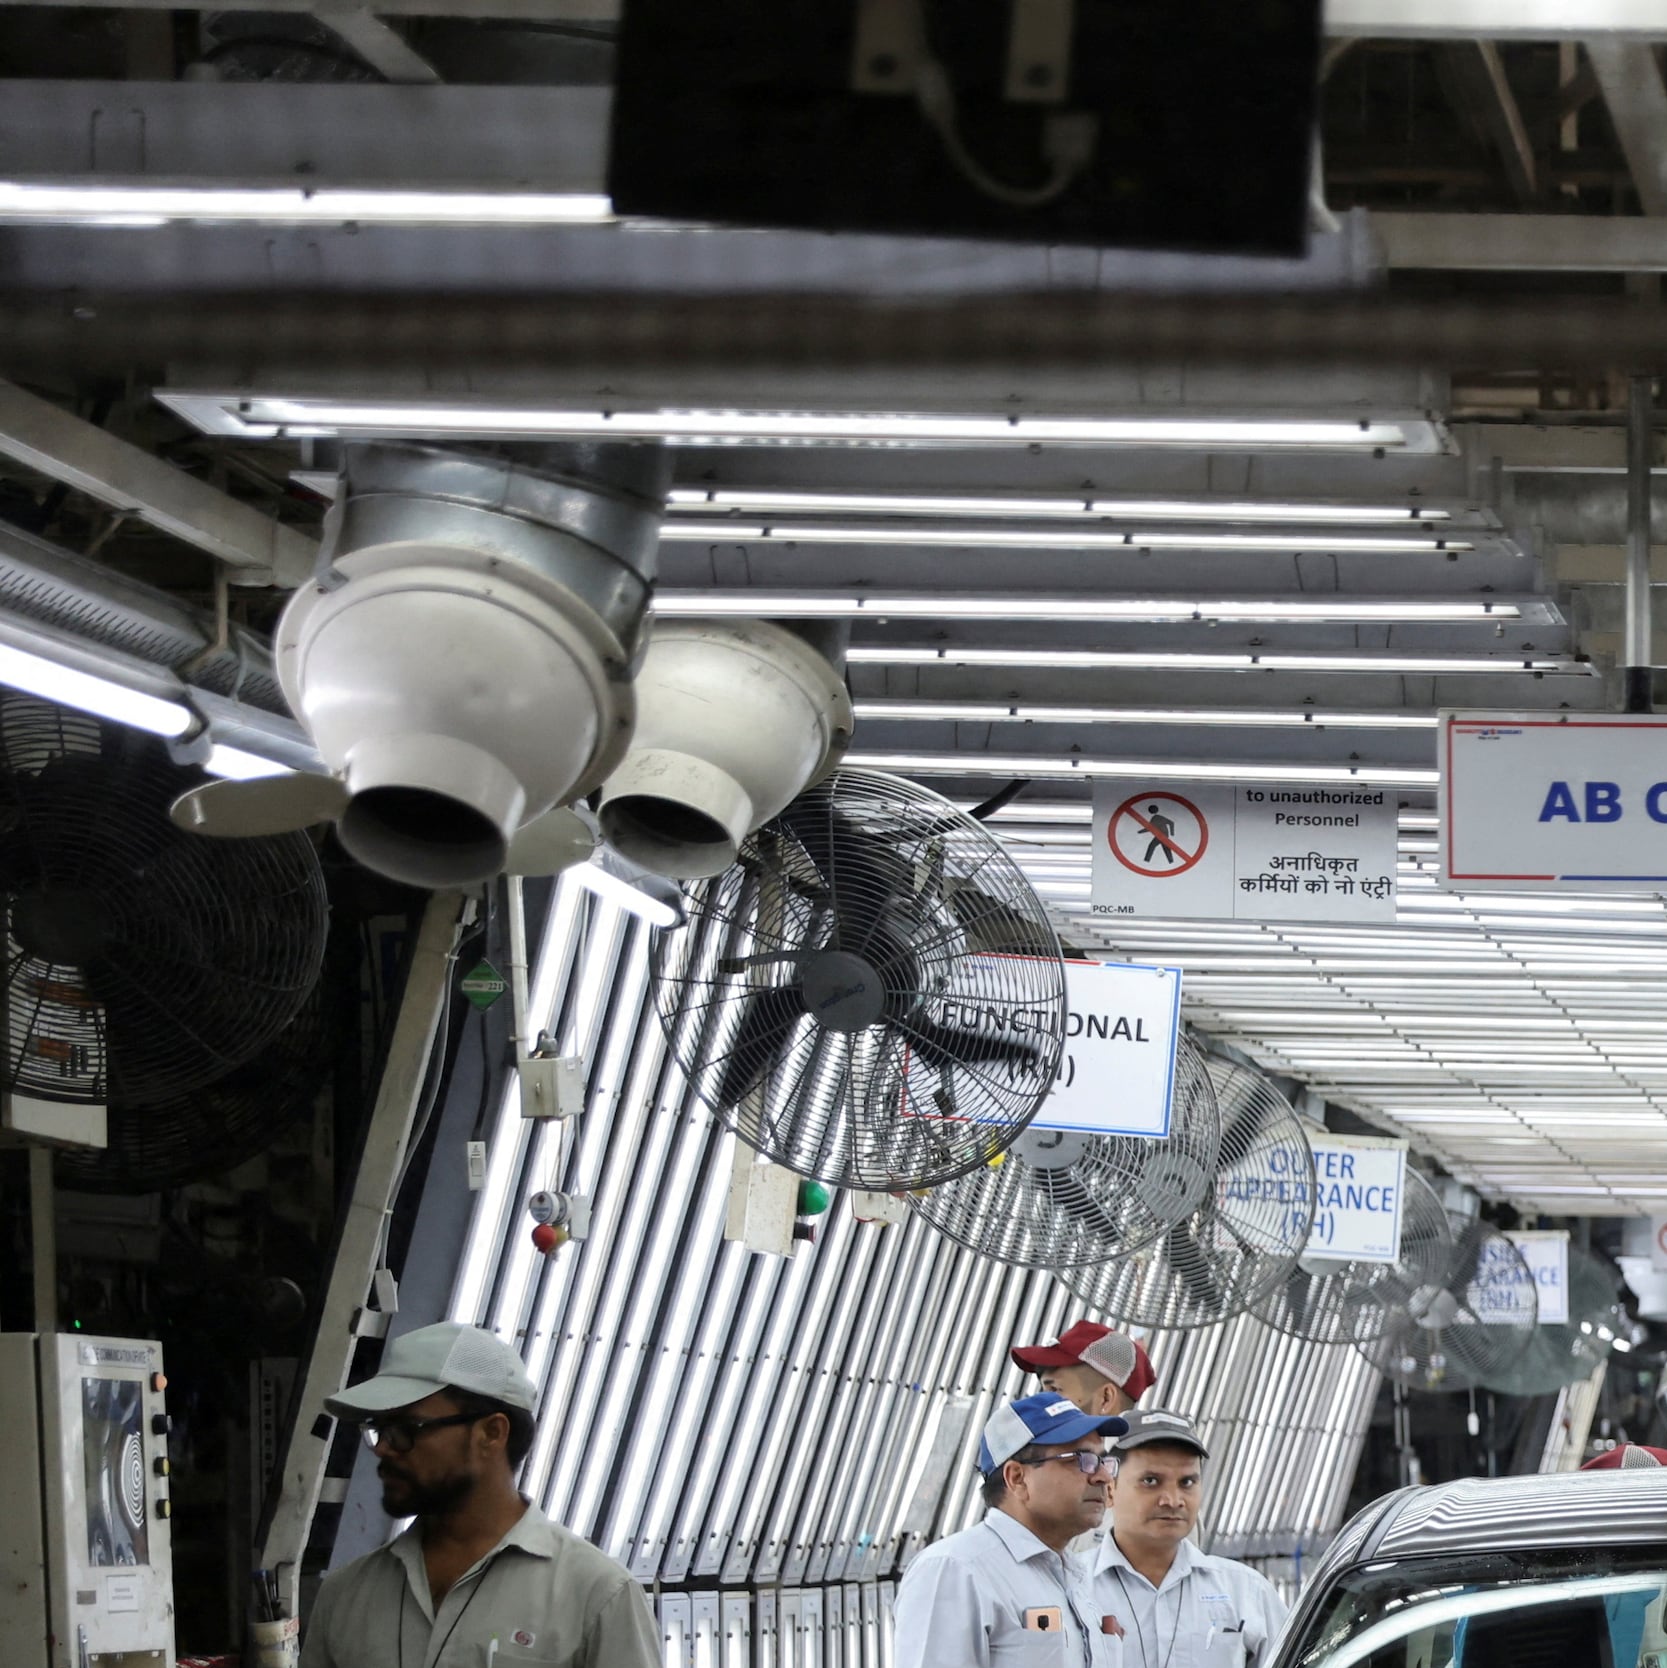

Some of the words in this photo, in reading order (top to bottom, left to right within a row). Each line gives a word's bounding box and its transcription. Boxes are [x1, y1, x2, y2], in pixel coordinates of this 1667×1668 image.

[1246, 789, 1265, 803] to
[1270, 790, 1384, 805] unauthorized
[1538, 781, 1623, 823] AB
[1275, 812, 1360, 827] Personnel
[1269, 852, 1359, 875] अनाधिकृत
[1239, 873, 1300, 894] कर्मियों
[1304, 874, 1329, 895] को
[1334, 875, 1354, 895] नो
[1359, 876, 1392, 899] एंट्री
[1093, 904, 1135, 914] PQC-MB
[1270, 1148, 1356, 1179] OUTER
[1225, 1176, 1394, 1213] APPEARANCE
